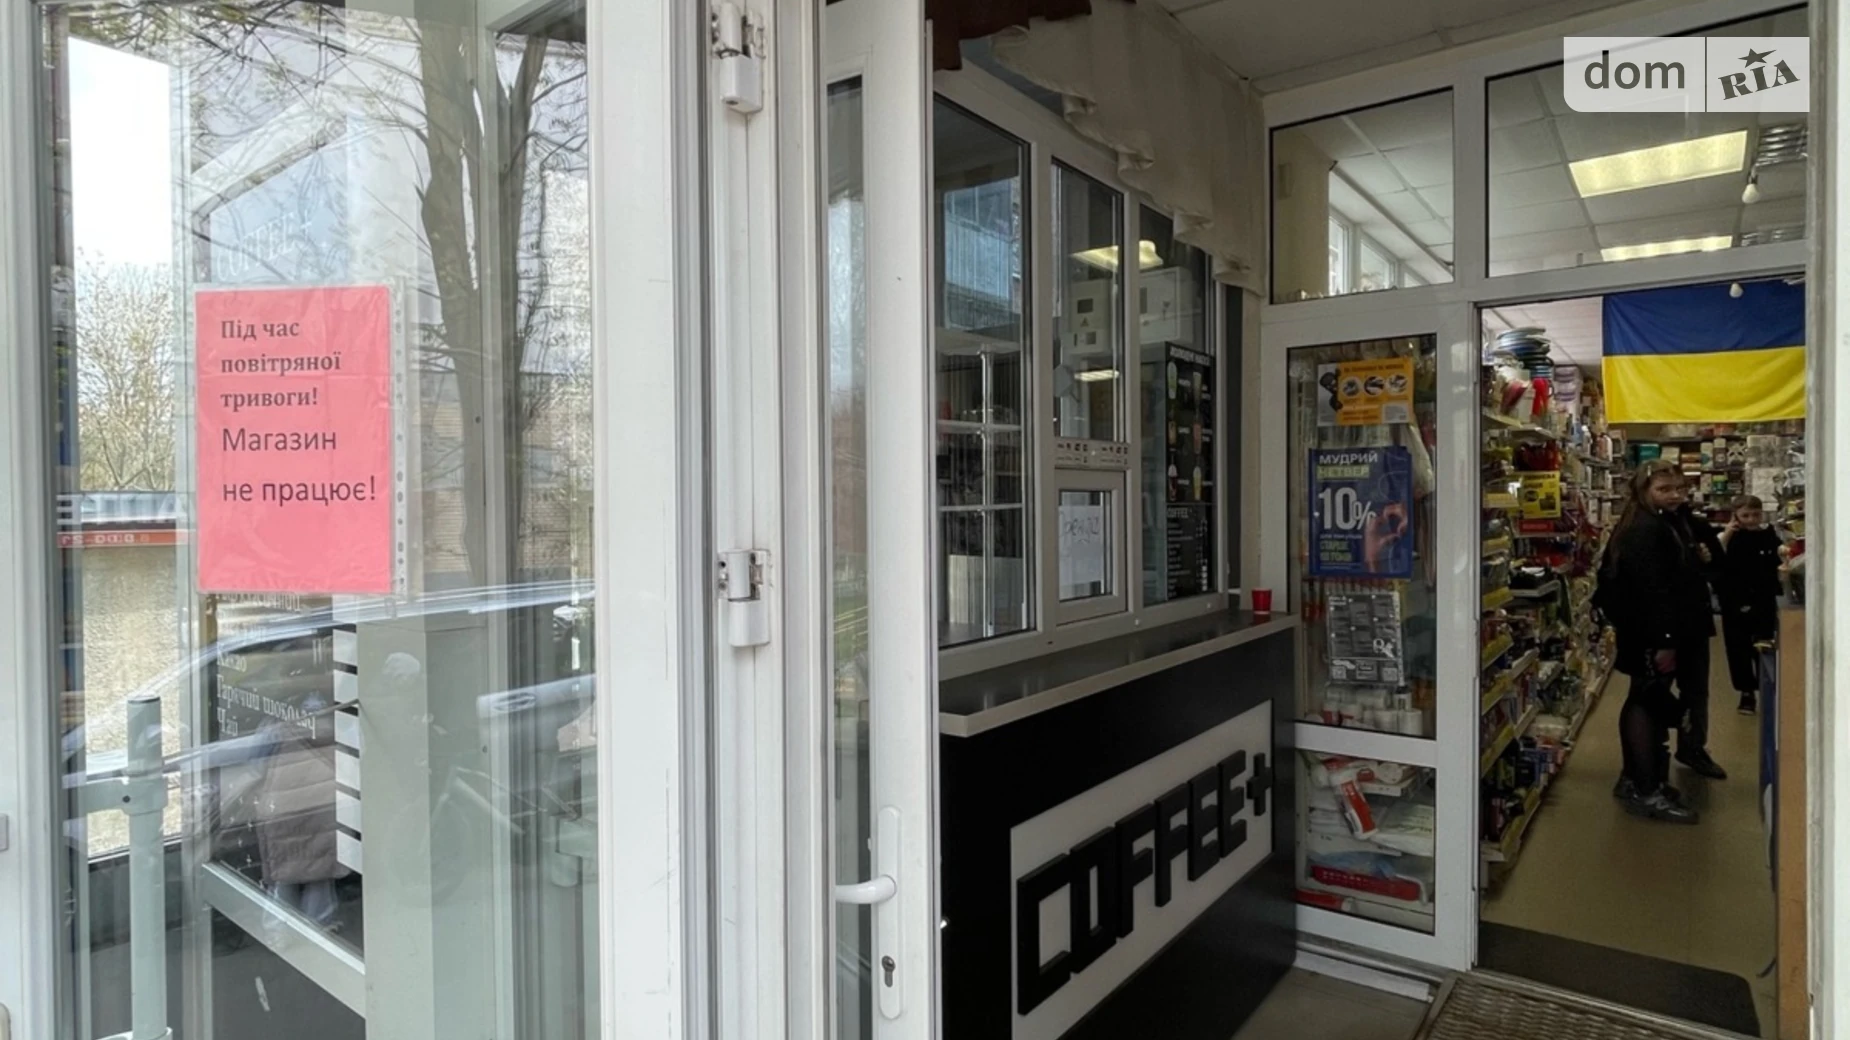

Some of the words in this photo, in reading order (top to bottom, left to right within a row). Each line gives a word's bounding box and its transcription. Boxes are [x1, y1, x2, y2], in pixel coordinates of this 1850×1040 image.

[221, 319, 257, 342] Під
[263, 322, 300, 338] час
[221, 351, 341, 375] повітряної
[221, 387, 318, 412] тривоги!
[222, 427, 337, 452] Магазин
[1319, 450, 1378, 464] МУДРИЙ
[223, 483, 253, 502] не
[262, 475, 376, 507] працює!
[1318, 486, 1377, 530] 10%
